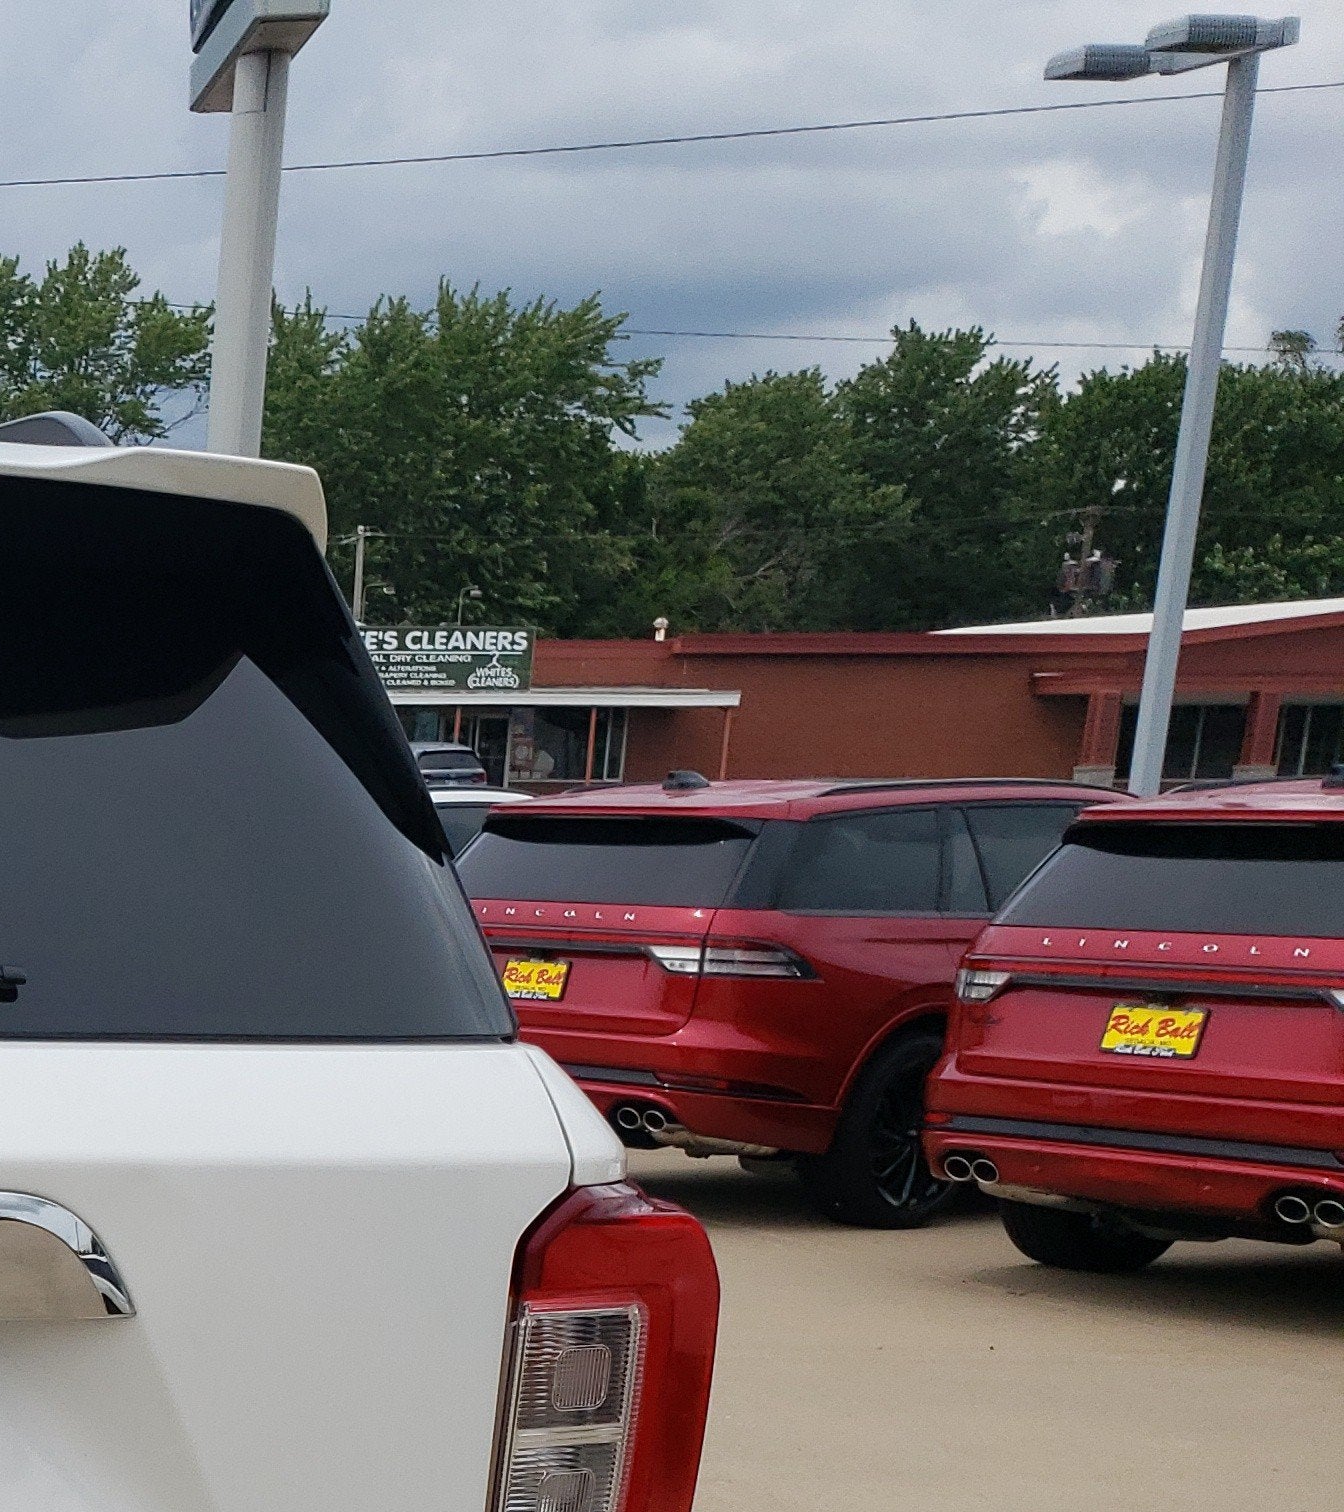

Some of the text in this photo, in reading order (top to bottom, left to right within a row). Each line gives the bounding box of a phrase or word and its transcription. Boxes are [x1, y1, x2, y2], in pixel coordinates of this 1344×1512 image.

[359, 630, 528, 651] E'S CLEANERS
[389, 654, 412, 663] DRY
[414, 654, 472, 663] CLEANING
[472, 906, 636, 921] INCOLN
[1042, 937, 1310, 958] LINCOLN
[1108, 1014, 1201, 1039] Rick Ball
